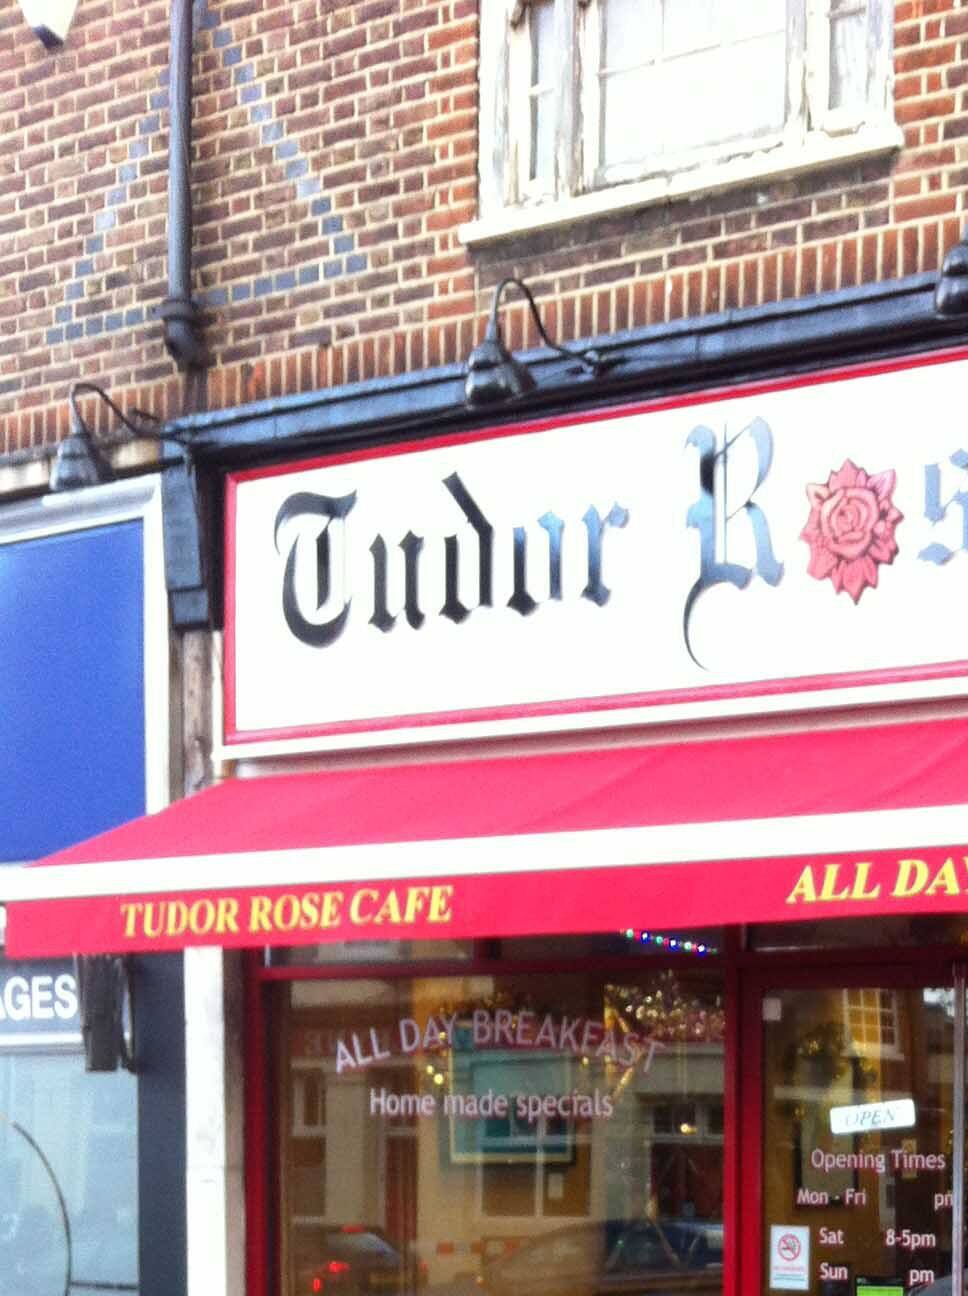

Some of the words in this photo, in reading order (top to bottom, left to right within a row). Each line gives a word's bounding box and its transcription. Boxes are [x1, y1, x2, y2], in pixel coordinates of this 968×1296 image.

[274, 472, 630, 648] Tudor
[786, 863, 881, 903] ALL
[121, 897, 239, 939] TUDOR
[248, 891, 343, 932] ROSE
[350, 884, 454, 924] CAFE
[0, 974, 78, 1021] GES
[335, 1027, 391, 1074] ALL
[399, 1013, 457, 1053] DAY
[472, 1009, 665, 1073] BREAKFAST
[370, 1087, 435, 1117] Home
[443, 1088, 509, 1117] made
[517, 1089, 614, 1123] specials
[845, 1108, 897, 1126] OPEN
[811, 1149, 886, 1172] Opening
[892, 1149, 946, 1169] Times
[797, 1189, 828, 1205] Mon
[845, 1188, 866, 1205] Fri
[819, 1227, 844, 1245] Sat
[886, 1228, 936, 1251] 8-5pm
[820, 1262, 848, 1280] Sun
[909, 1269, 934, 1286] pm
